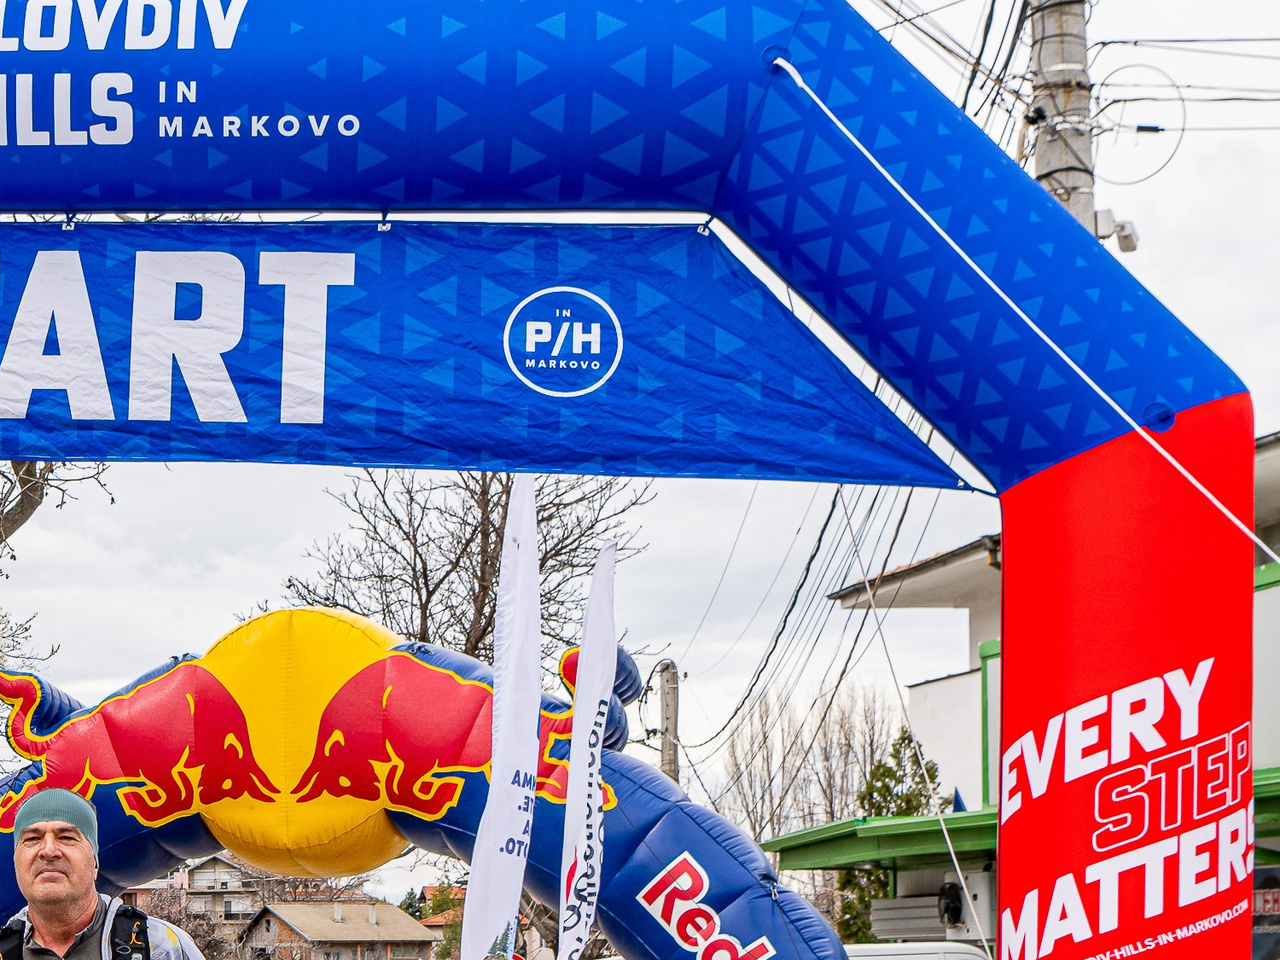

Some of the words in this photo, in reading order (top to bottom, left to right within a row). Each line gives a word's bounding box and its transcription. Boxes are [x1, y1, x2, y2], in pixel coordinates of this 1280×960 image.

[159, 81, 196, 103] IN
[159, 115, 360, 137] MARKOVO
[556, 309, 570, 317] IN
[526, 321, 600, 356] P/H
[526, 359, 600, 370] MARKOVO
[1001, 657, 1215, 825] EVERY
[1092, 721, 1251, 852] STEP
